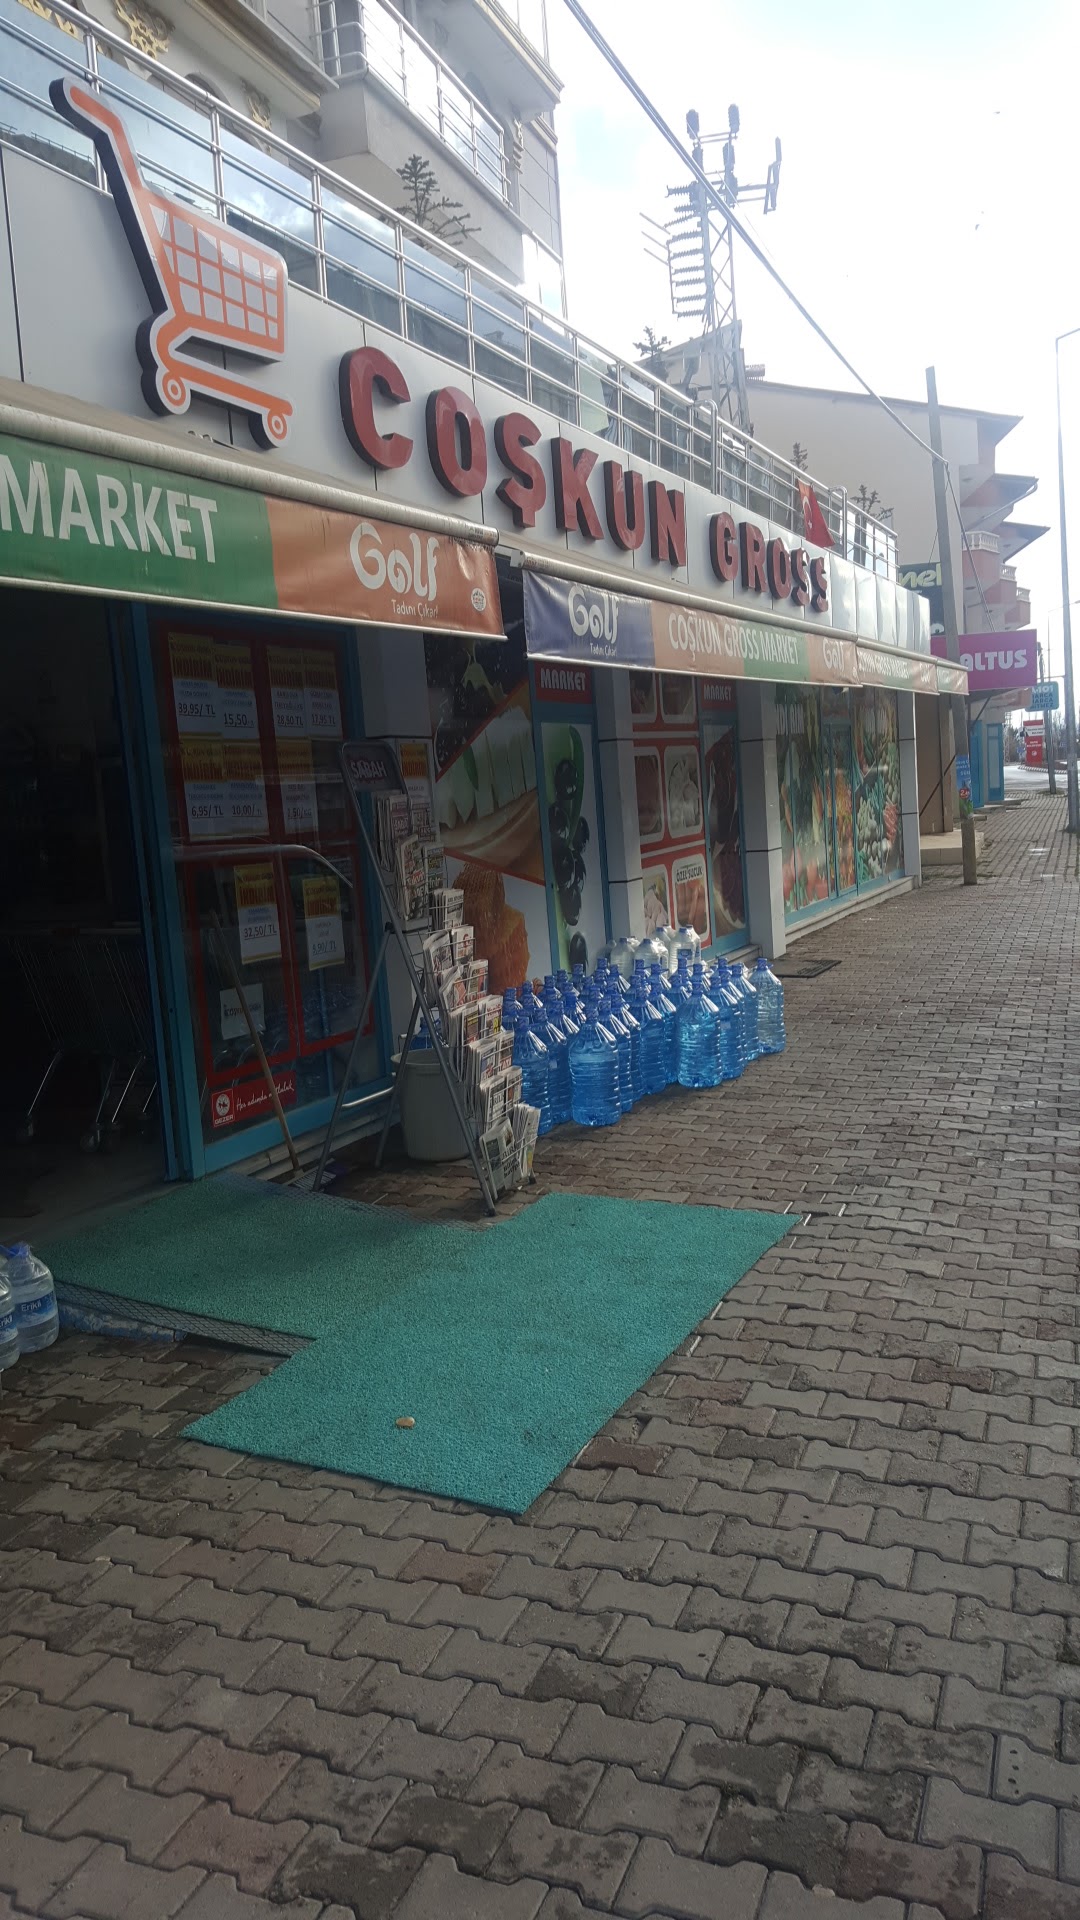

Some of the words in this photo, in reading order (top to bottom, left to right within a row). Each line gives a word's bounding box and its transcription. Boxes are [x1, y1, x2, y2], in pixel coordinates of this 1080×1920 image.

[339, 346, 686, 567] COŞKUN
[709, 512, 829, 613] GROSS
[0, 455, 218, 563] MARKET
[350, 522, 440, 601] Golf
[568, 585, 619, 644] Golf
[668, 612, 723, 661] COŞKUN
[724, 624, 760, 660] GROSS
[760, 631, 799, 665] MARKET
[960, 649, 1028, 672] ALTUS
[540, 667, 587, 692] MARKET
[703, 684, 732, 702] MARKET
[205, 704, 216, 715] TL
[224, 713, 247, 726] 15,50
[350, 759, 388, 780] SABAH
[269, 924, 278, 934] TL
[214, 1114, 234, 1125] GEZER
